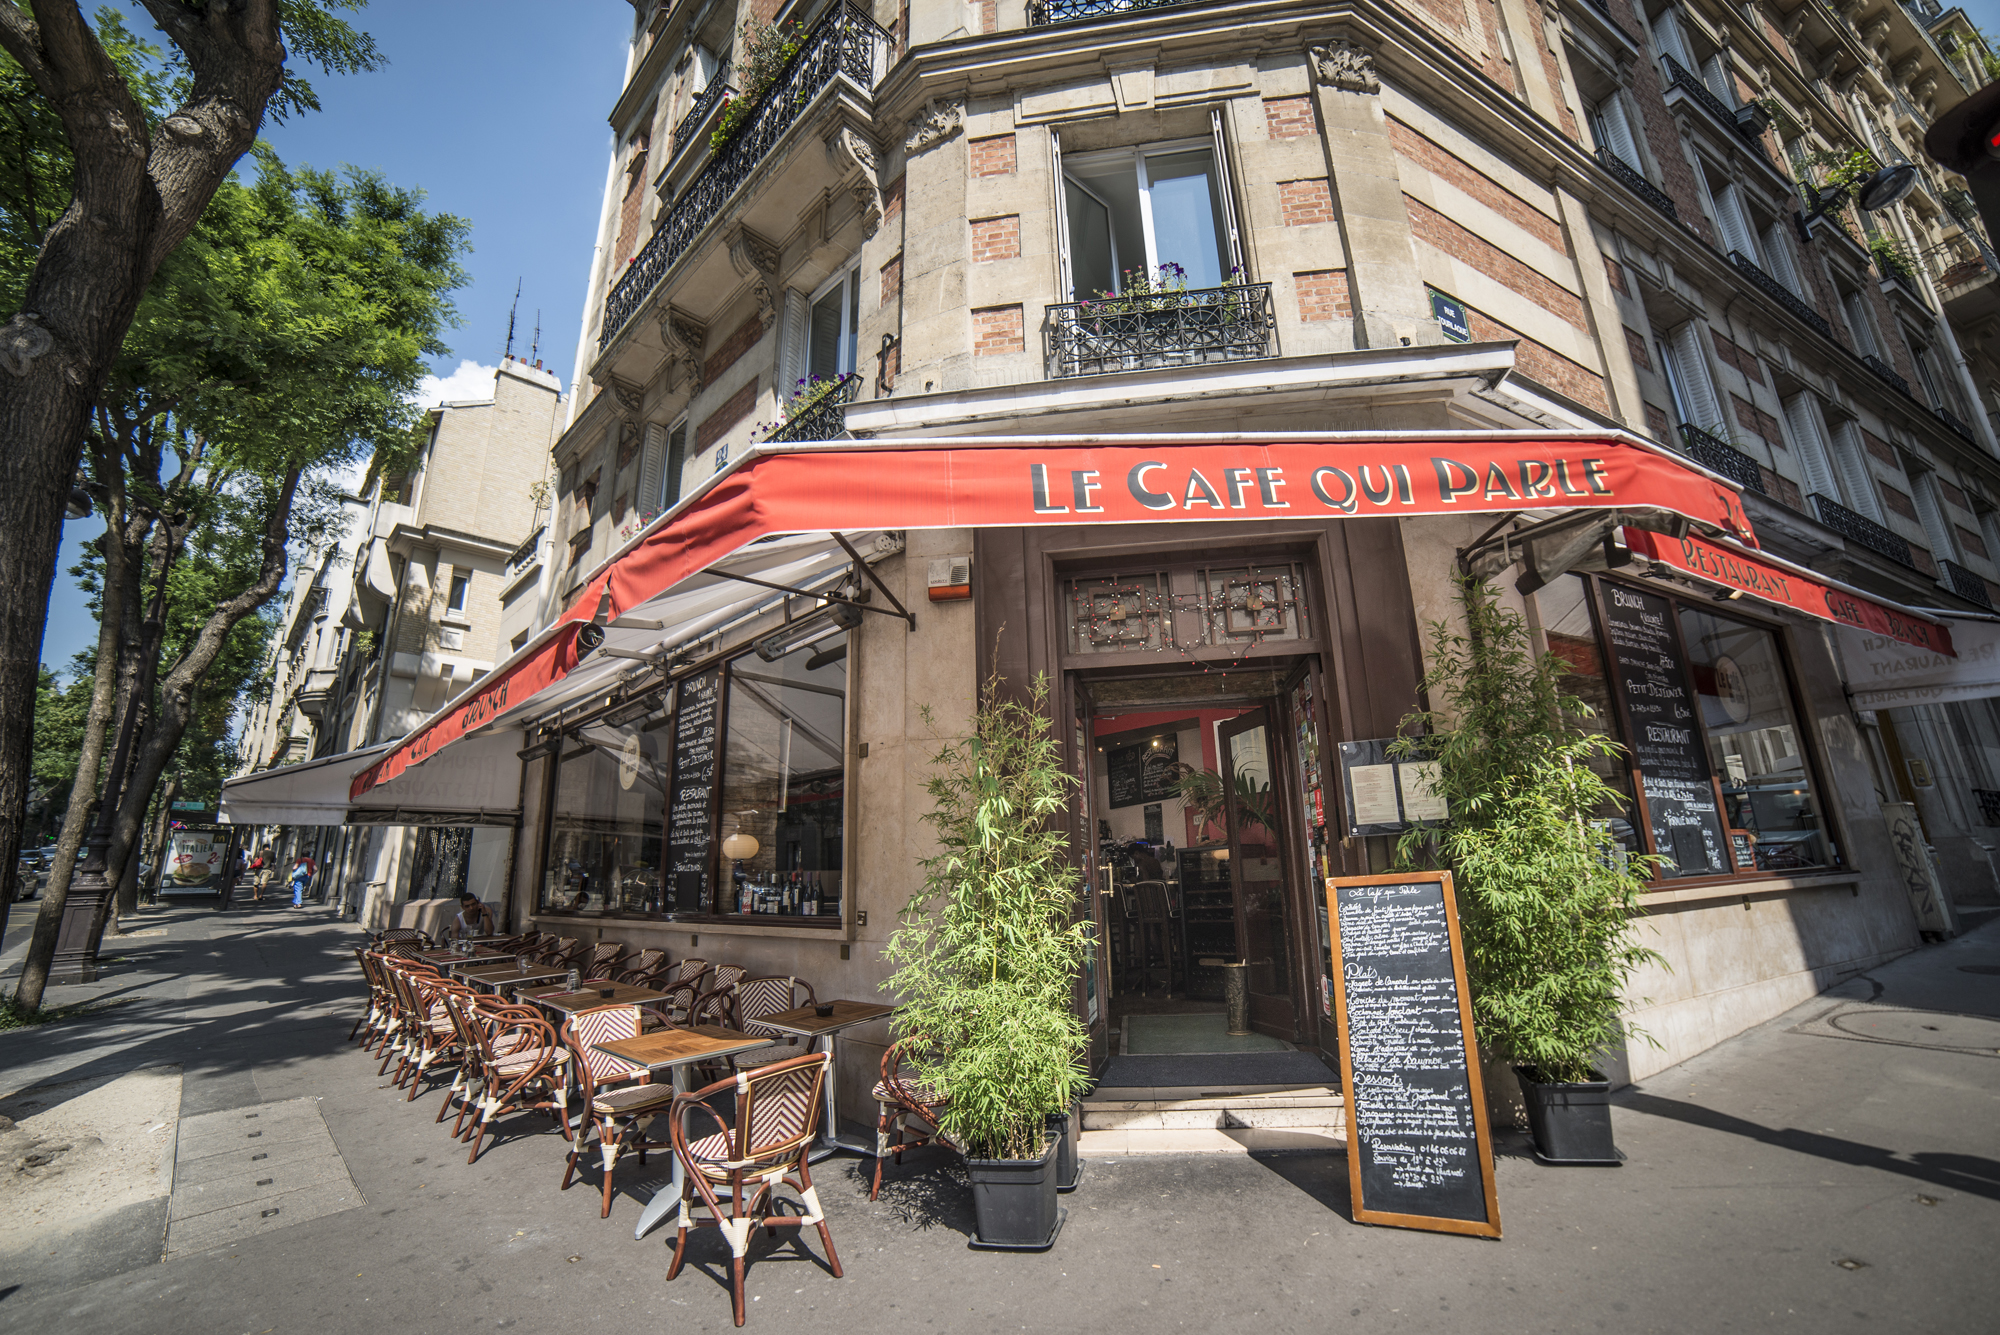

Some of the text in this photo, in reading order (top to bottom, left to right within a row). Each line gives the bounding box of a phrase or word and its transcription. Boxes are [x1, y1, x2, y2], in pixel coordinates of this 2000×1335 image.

[1443, 305, 1456, 318] RUE
[1030, 456, 1616, 514] LE CAFE QUI PARLE
[1680, 537, 1793, 603] RESTAURANT
[1824, 590, 1865, 626] CAFE
[1611, 588, 1645, 610] BRUNCH
[1626, 679, 1647, 694] PETIT
[1645, 726, 1691, 745] RESTAURANT
[182, 843, 215, 853] ITALIEN
[1344, 963, 1378, 979] Plats
[1353, 1071, 1404, 1086] Desserts
